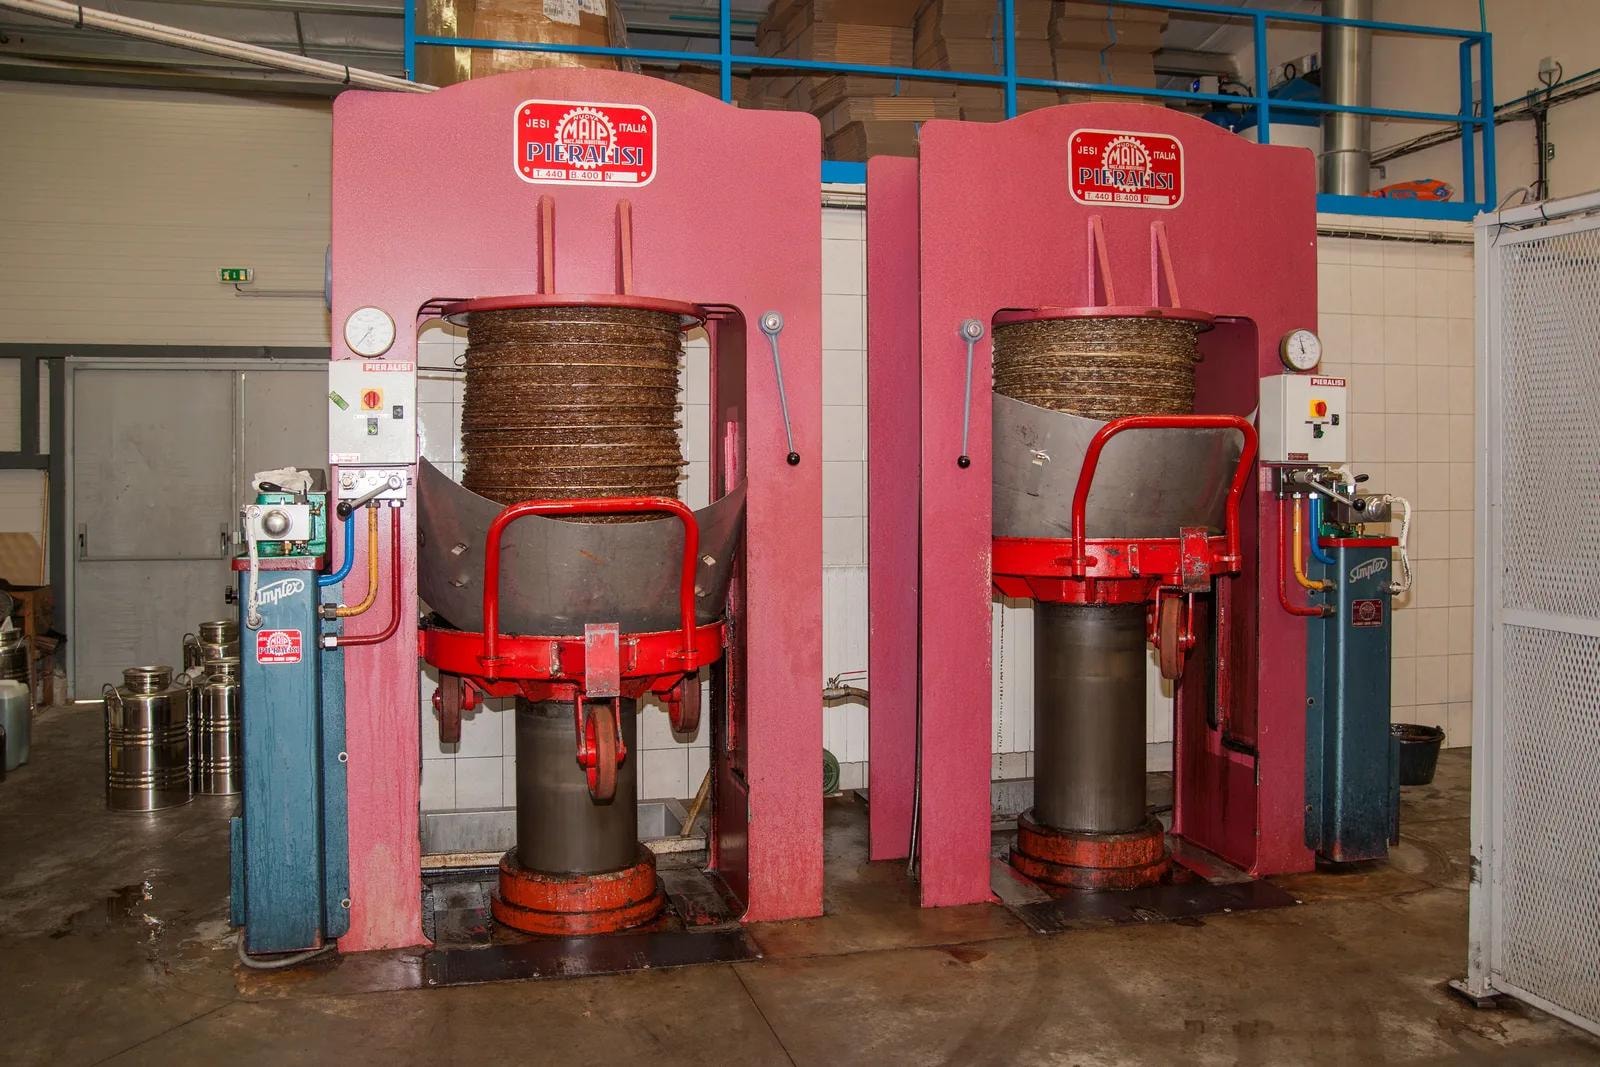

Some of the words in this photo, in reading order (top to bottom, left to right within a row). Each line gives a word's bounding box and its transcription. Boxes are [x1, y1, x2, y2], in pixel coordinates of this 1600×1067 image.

[526, 119, 550, 129] JESI
[619, 123, 648, 133] ITALIA
[563, 119, 609, 140] MAIP
[527, 142, 644, 166] PIERALISI
[1077, 146, 1098, 155] JESI
[1109, 147, 1146, 166] MAIP
[1153, 151, 1177, 161] ITALIA
[545, 170, 563, 178] 440
[581, 171, 599, 179] 400
[1079, 167, 1174, 191] PIERALISI
[1124, 194, 1139, 202] 400
[366, 363, 412, 372] PIERALISI
[1312, 378, 1345, 386] PIERALISI
